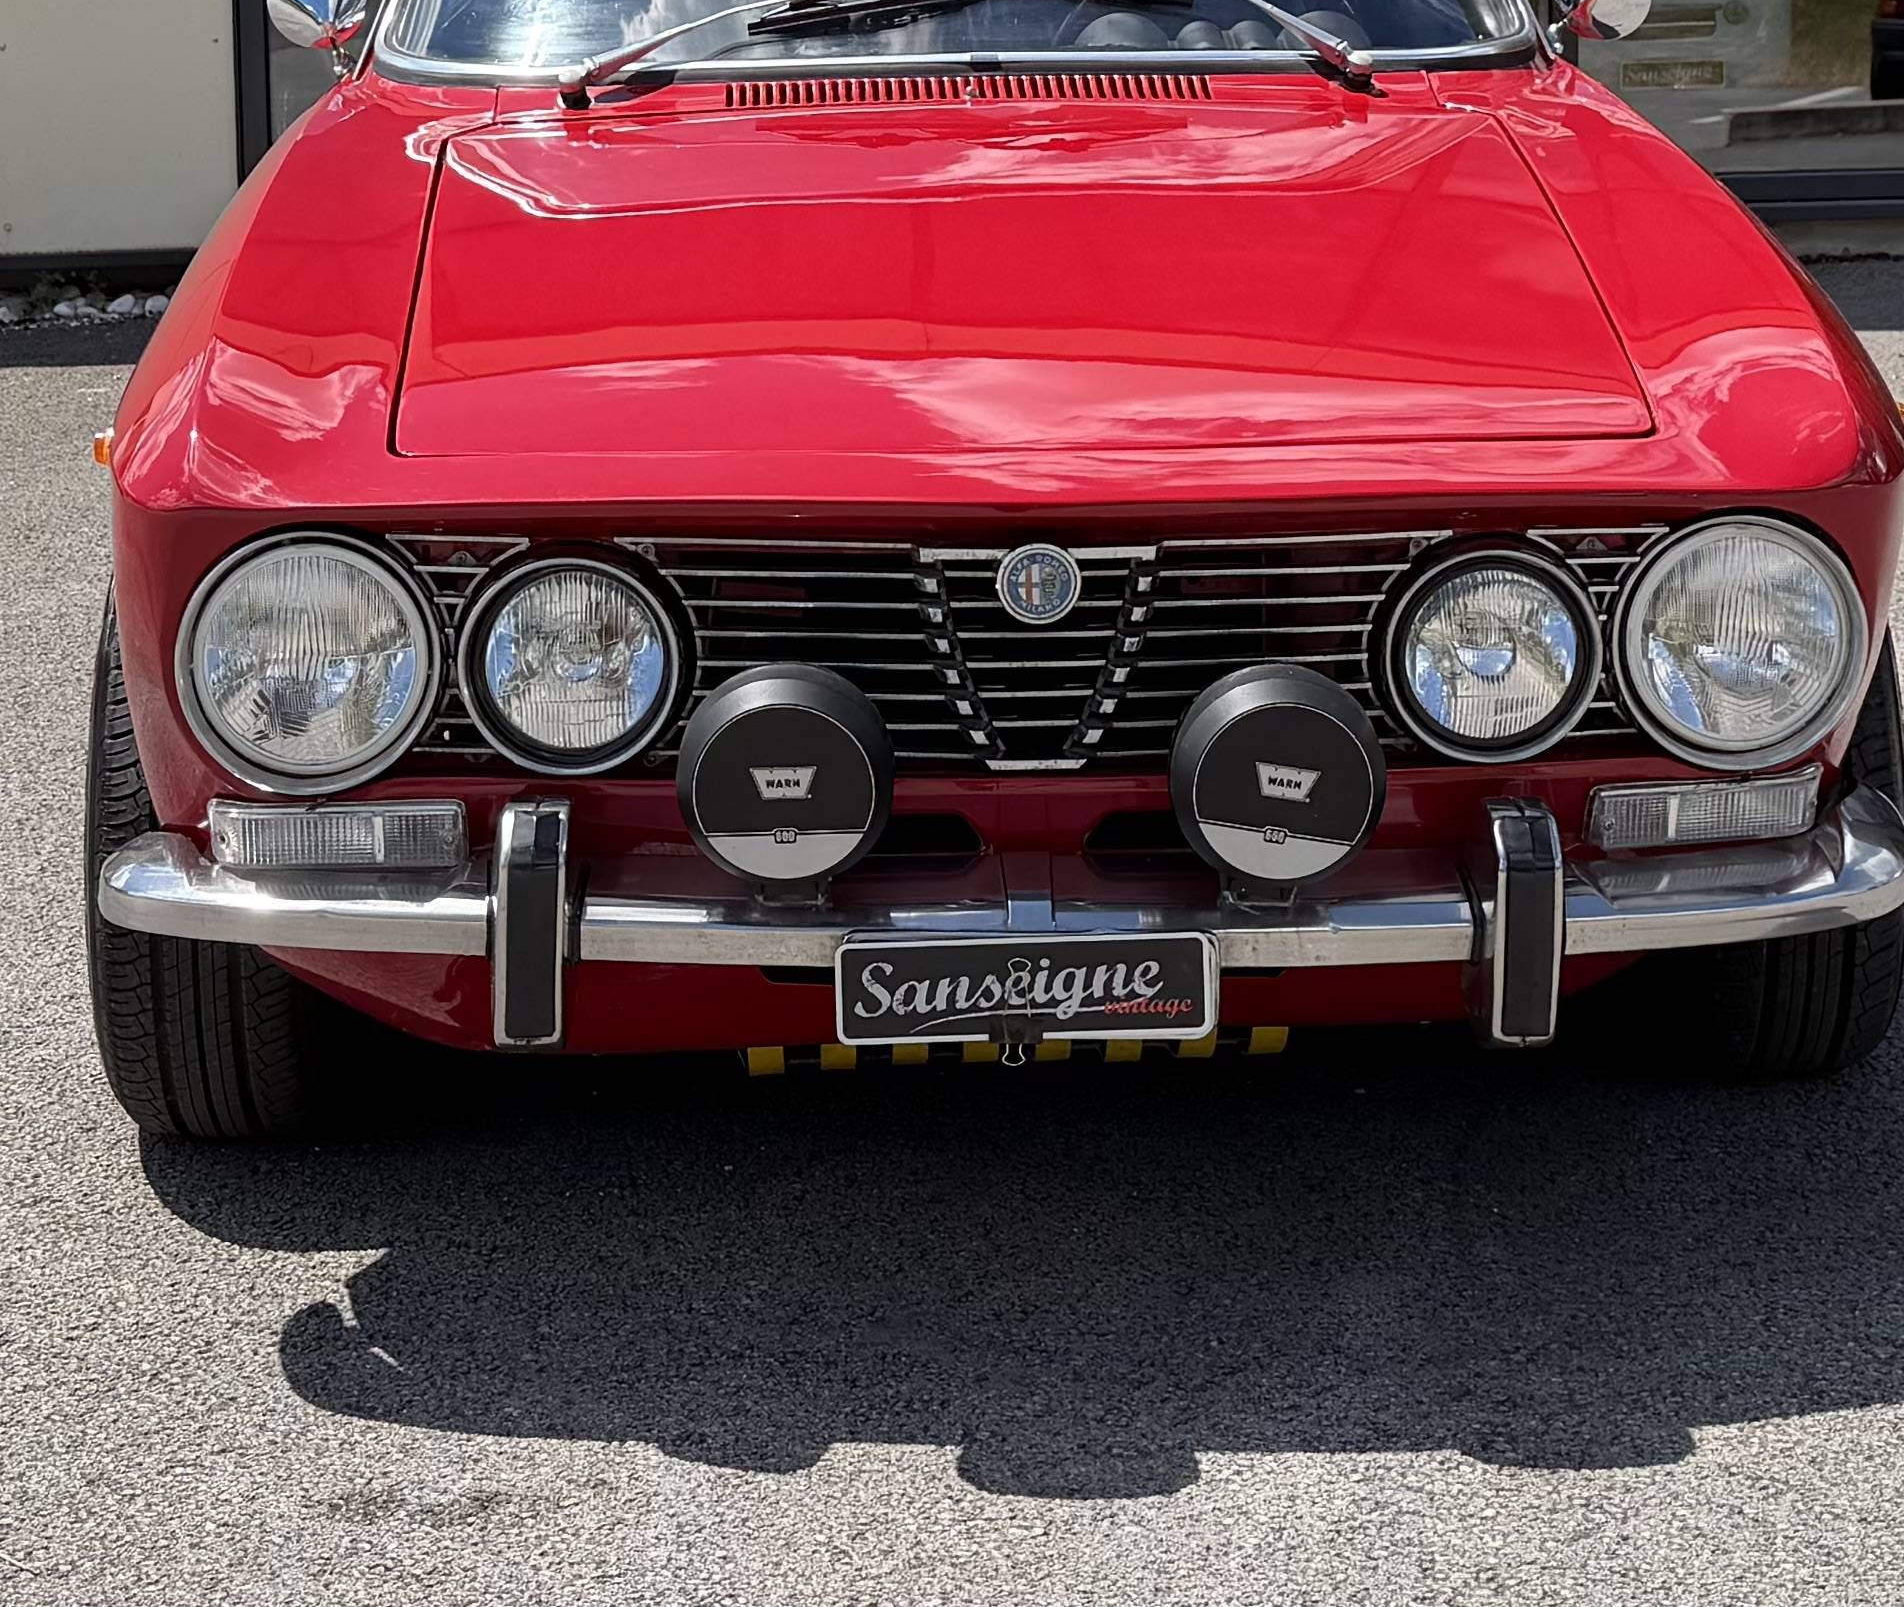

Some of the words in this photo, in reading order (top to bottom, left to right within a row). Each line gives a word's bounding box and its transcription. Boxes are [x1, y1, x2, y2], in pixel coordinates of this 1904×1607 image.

[766, 778, 800, 789] WARN
[1268, 776, 1302, 790] WARN
[853, 957, 1165, 1020] Sanseigne
[1103, 996, 1193, 1020] vintage
